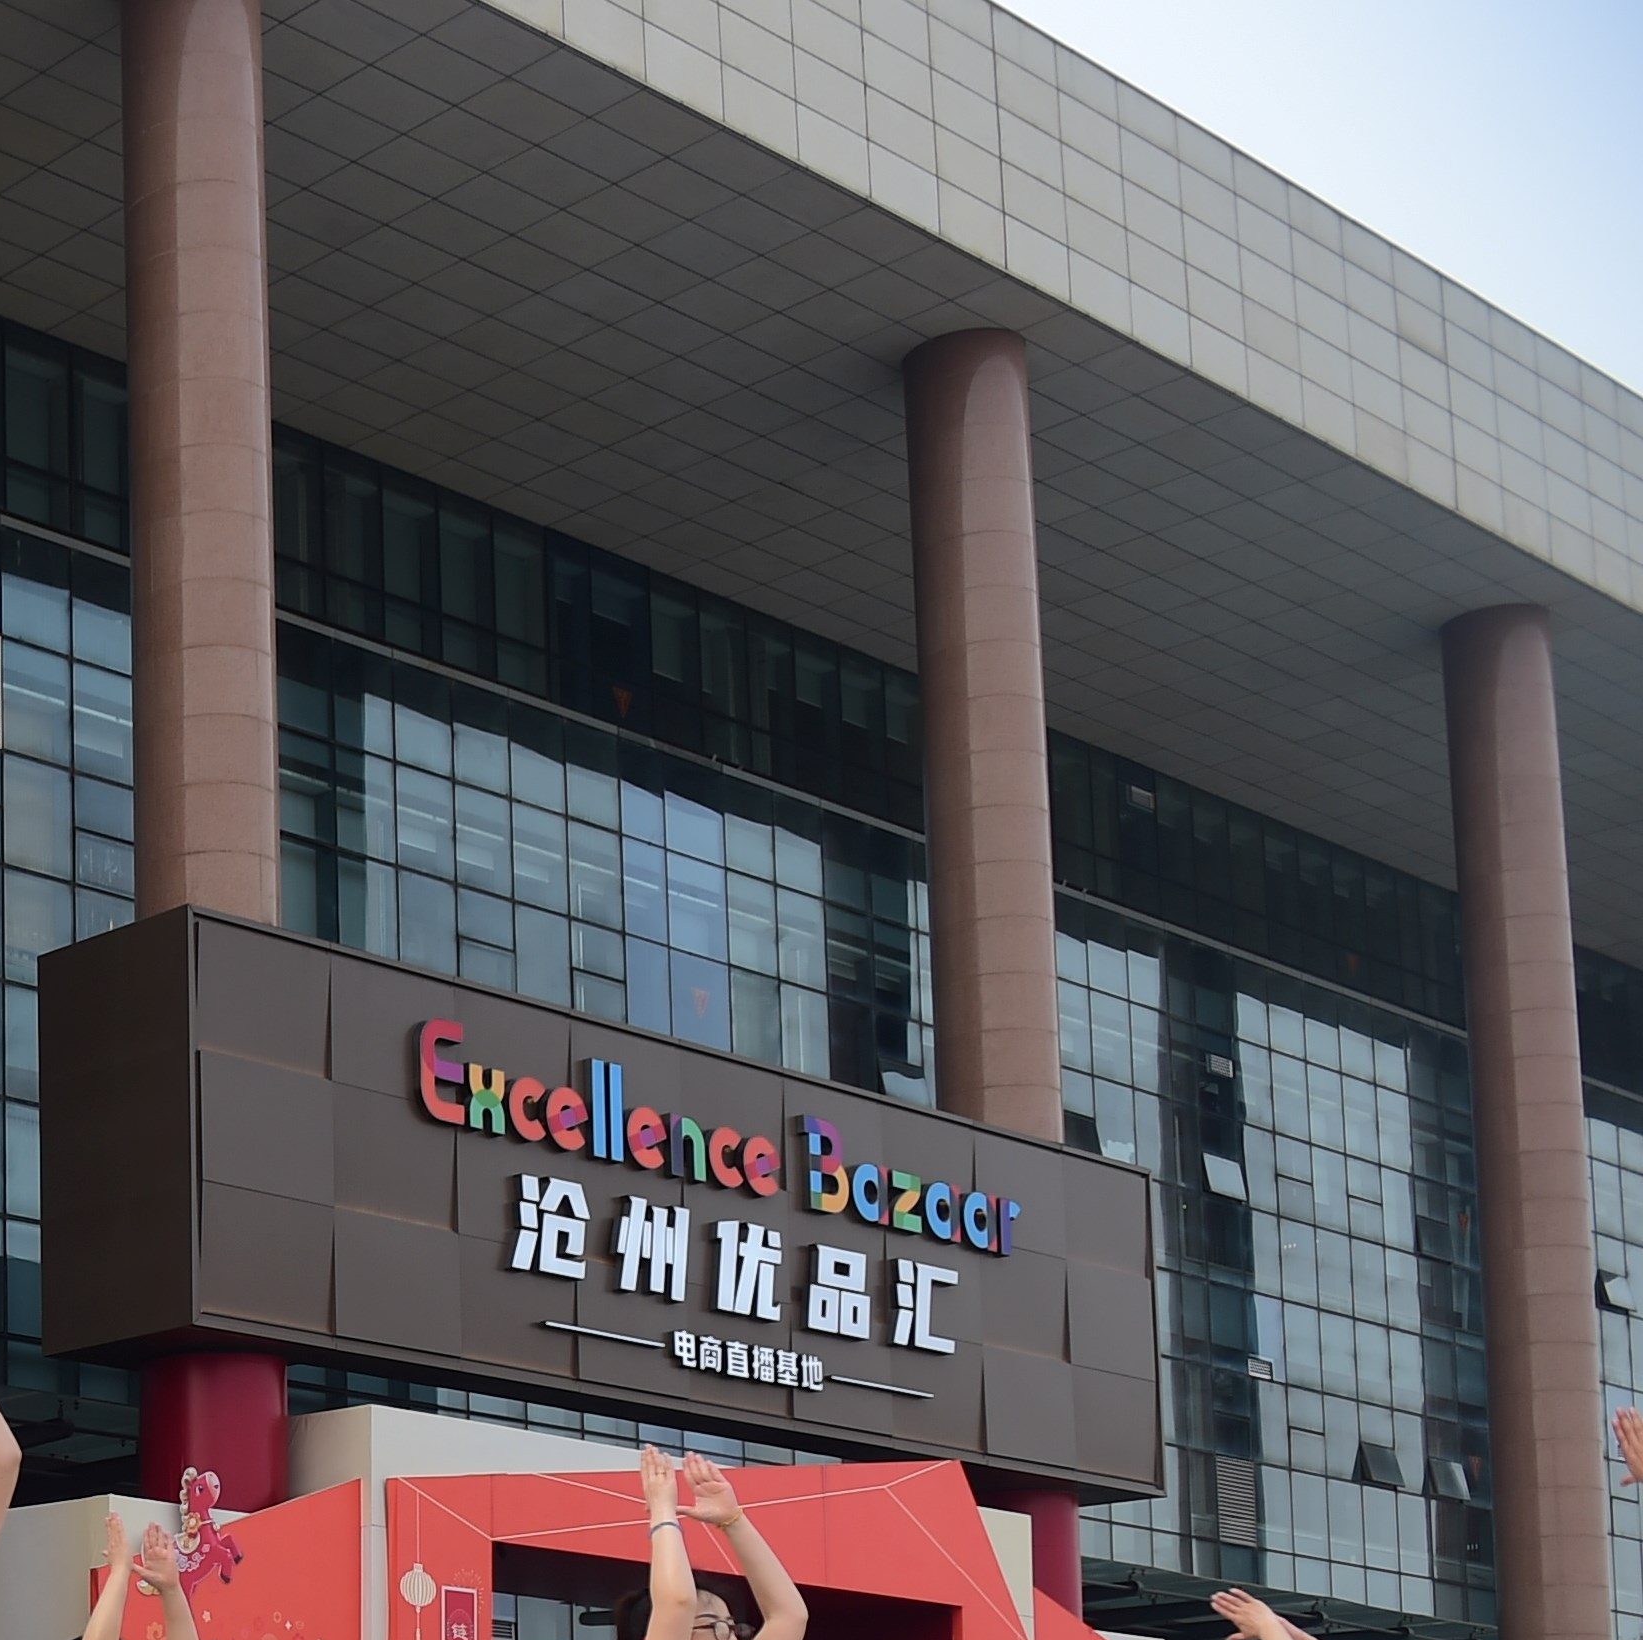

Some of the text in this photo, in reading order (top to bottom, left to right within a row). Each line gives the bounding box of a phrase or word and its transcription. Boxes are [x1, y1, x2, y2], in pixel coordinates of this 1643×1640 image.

[419, 1018, 1021, 1256] Excellence Bazaar
[512, 1174, 959, 1355] 沧州优品汇
[672, 1330, 824, 1391] 电商直播基地
